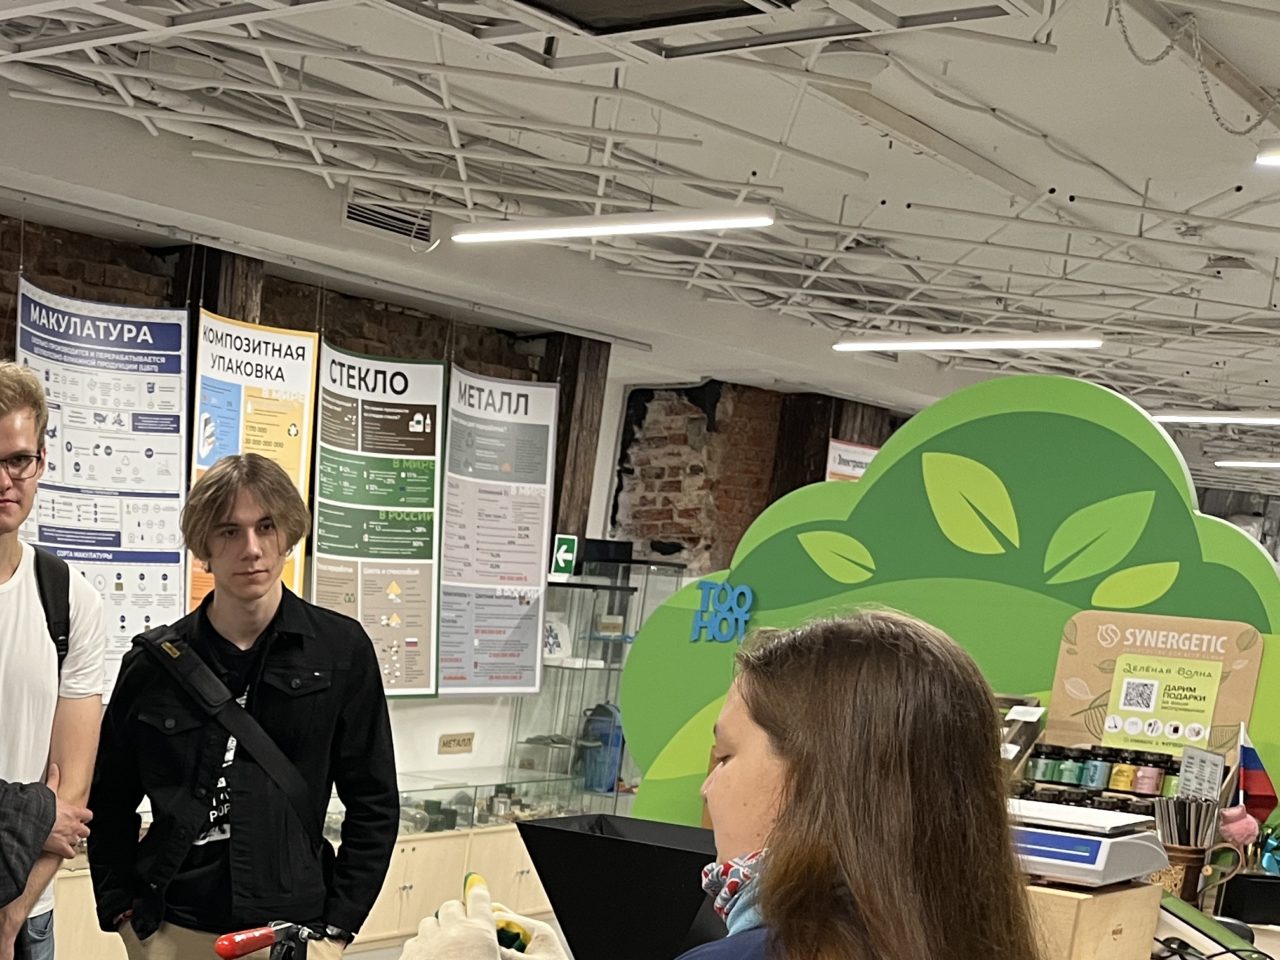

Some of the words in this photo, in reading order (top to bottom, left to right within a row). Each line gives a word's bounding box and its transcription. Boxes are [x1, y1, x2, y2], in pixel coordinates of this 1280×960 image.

[30, 303, 154, 344] МАКУЛАТУРА
[203, 325, 306, 361] КОМПОЗИТНАЯ
[211, 353, 285, 382] УПАКОВКА
[329, 359, 409, 396] СТЕКЛО
[458, 381, 529, 416] МЕТАЛЛ
[696, 580, 753, 614] TOO
[690, 610, 751, 645] HOT
[1124, 628, 1228, 653] SYNERGETIC
[1162, 692, 1206, 702] ПОДАРКИ
[1164, 684, 1196, 693] ДАРИМ
[442, 737, 473, 749] МЕТАЛЛ
